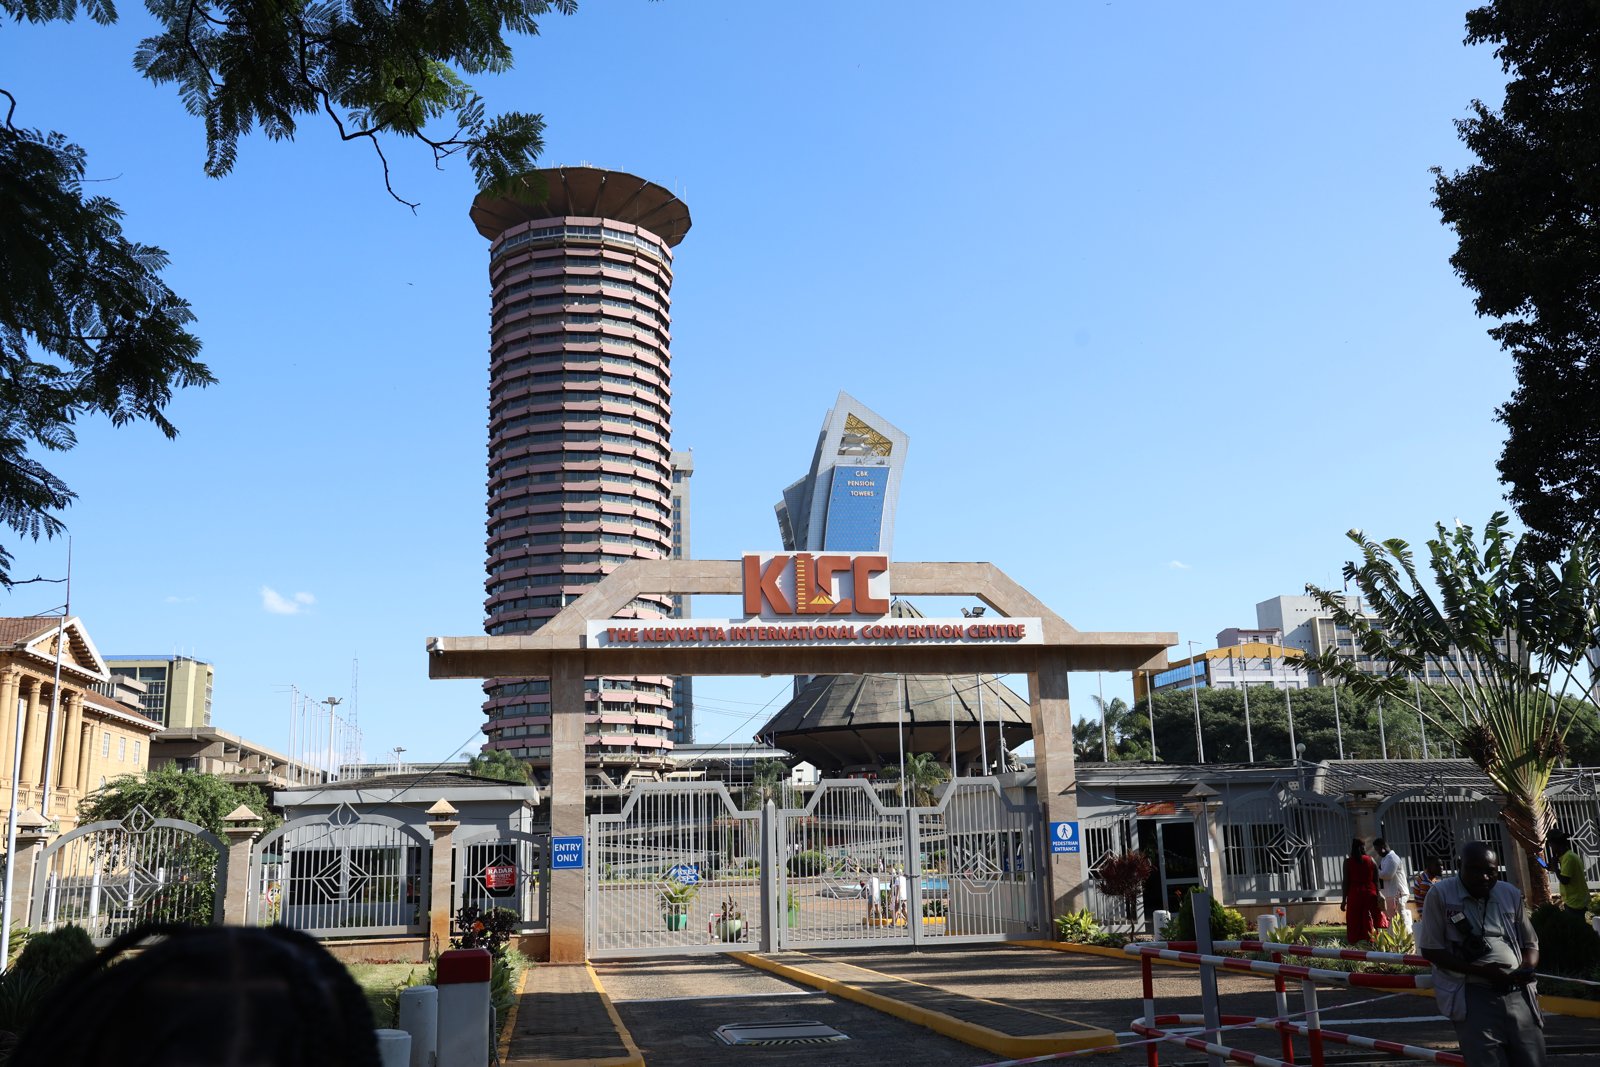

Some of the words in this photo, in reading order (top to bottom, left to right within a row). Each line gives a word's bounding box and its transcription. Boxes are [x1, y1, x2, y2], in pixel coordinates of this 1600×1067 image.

[744, 553, 890, 615] KICC
[607, 627, 639, 642] THE
[643, 627, 727, 642] KENYATTA
[730, 625, 858, 642] INTERNATIONAL
[861, 624, 964, 640] CONVENTION
[968, 623, 1026, 638] CENTRE
[554, 843, 581, 851] ENTRY
[556, 853, 579, 862] ONLY
[488, 867, 513, 875] RADAR
